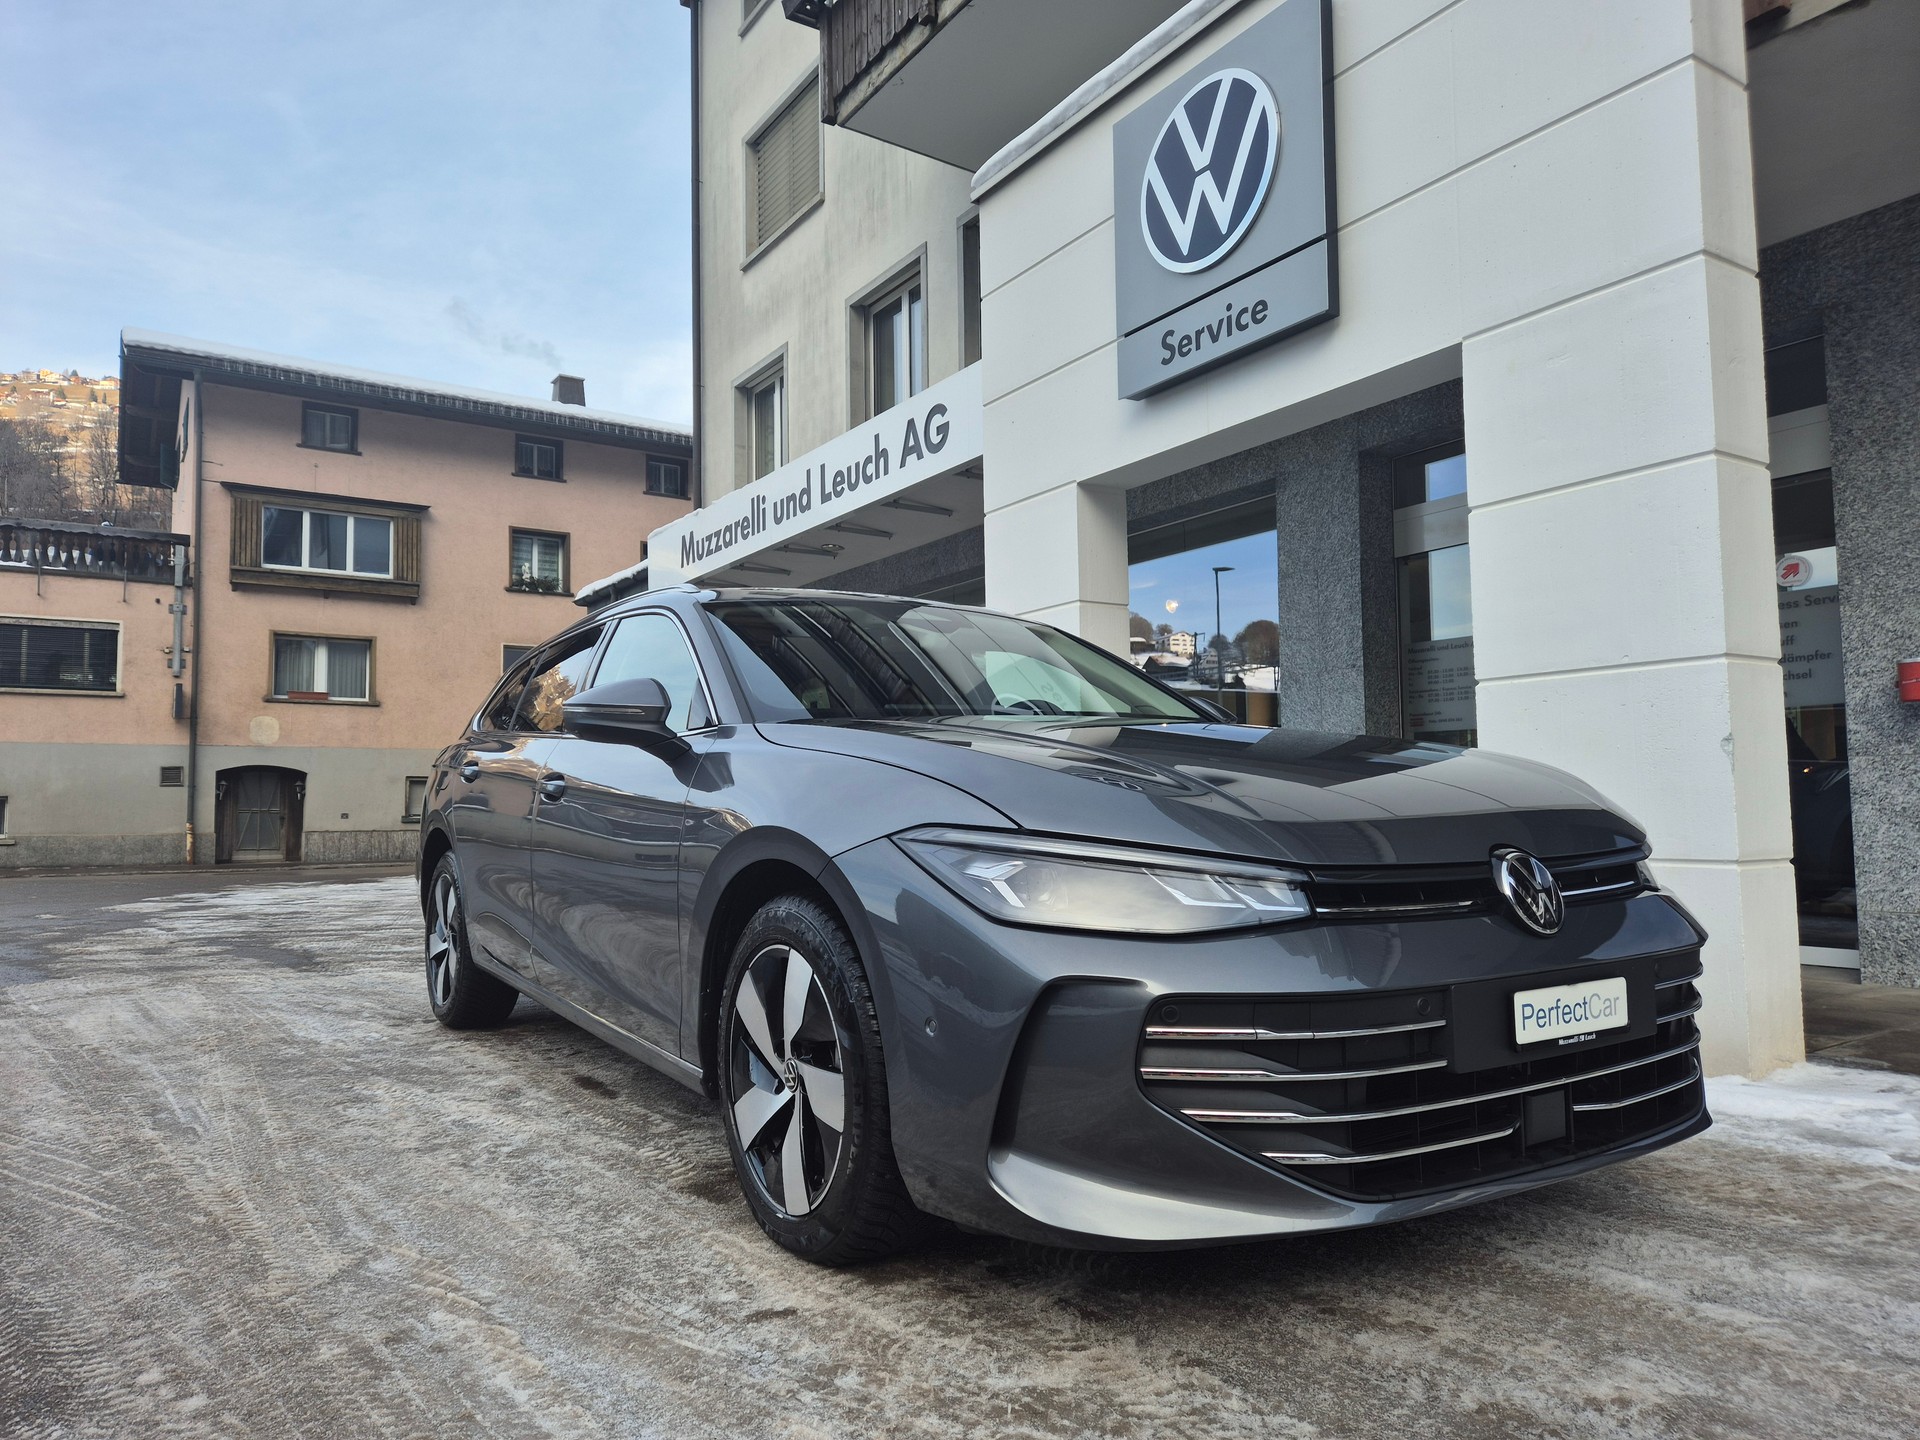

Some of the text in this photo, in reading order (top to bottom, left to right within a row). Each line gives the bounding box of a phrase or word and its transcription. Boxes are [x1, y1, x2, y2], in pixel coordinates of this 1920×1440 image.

[1160, 298, 1269, 366] Service
[680, 402, 951, 569] Muzzarelli und Leuch AG
[1521, 992, 1620, 1032] PerfectCar
